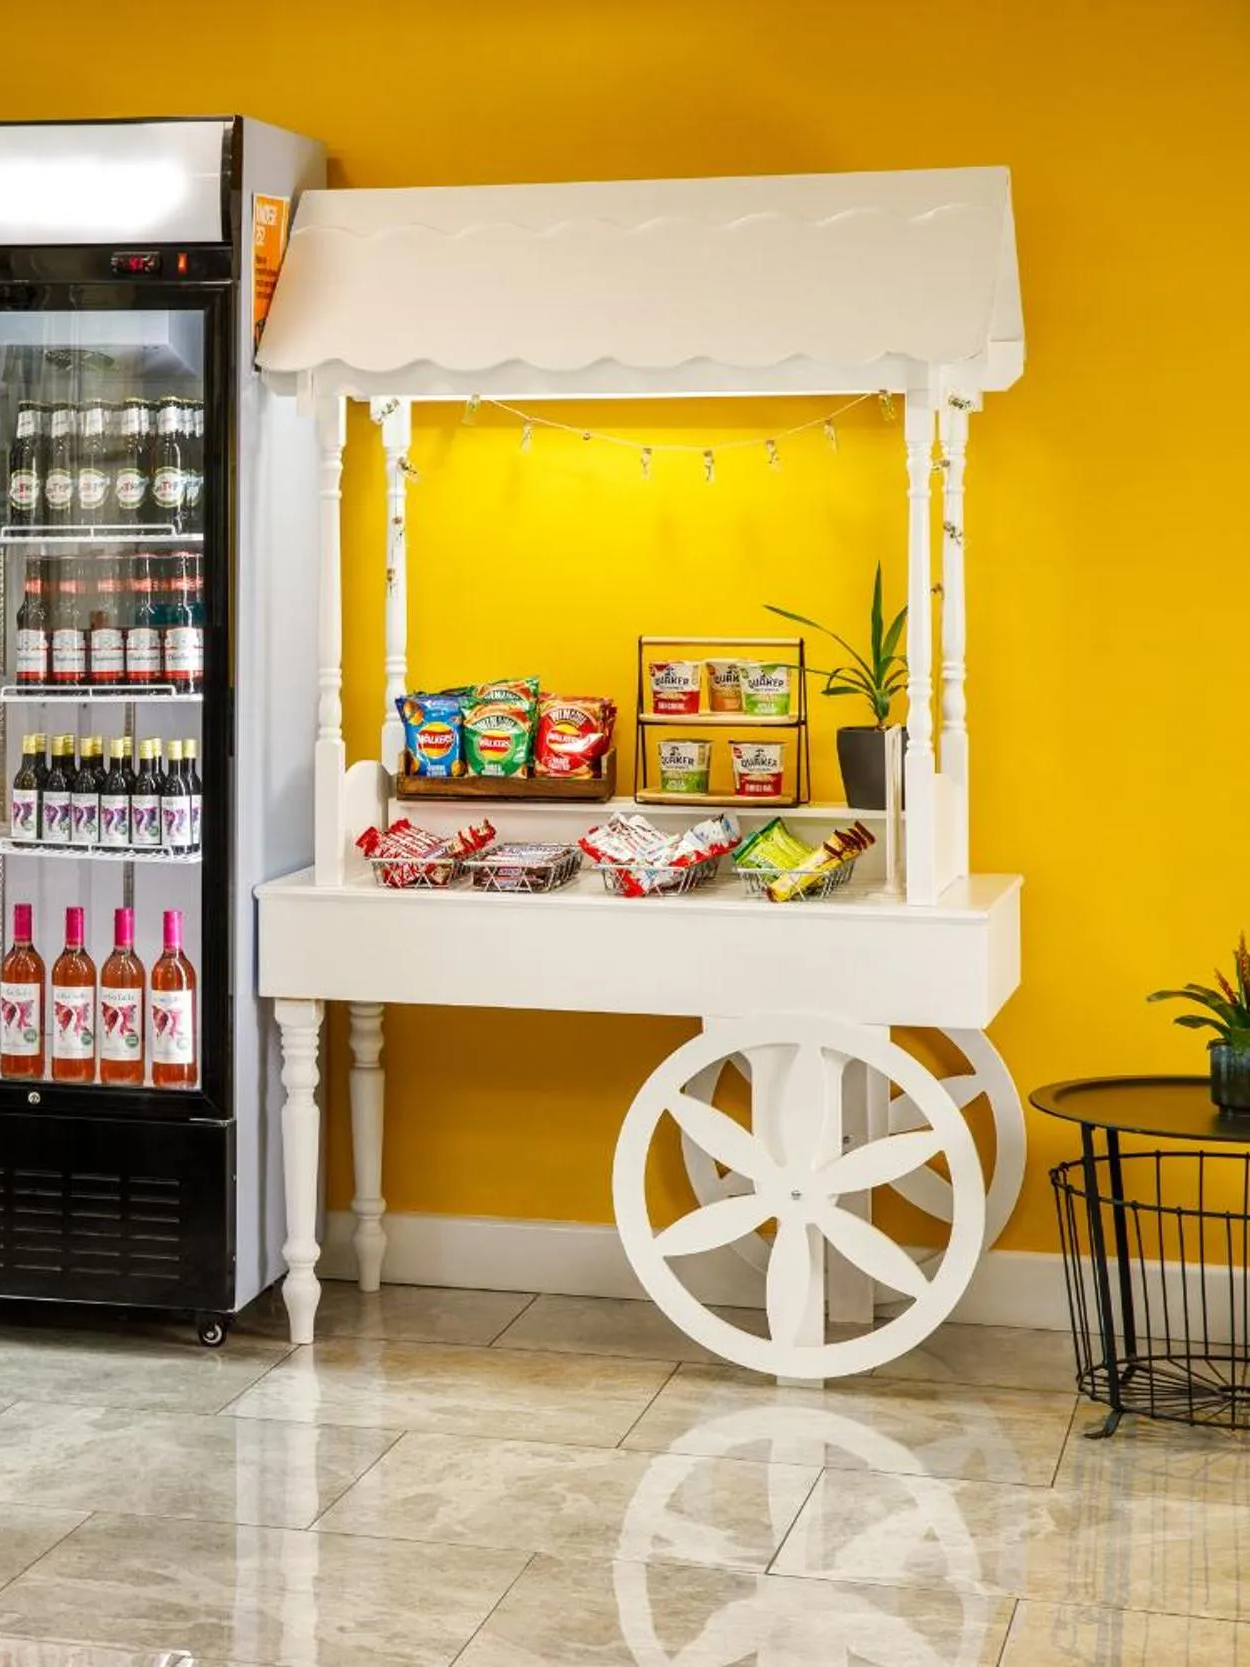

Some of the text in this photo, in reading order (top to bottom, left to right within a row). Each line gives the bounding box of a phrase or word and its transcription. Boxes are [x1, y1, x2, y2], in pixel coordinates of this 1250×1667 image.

[654, 677, 689, 687] QUAKER
[714, 674, 740, 685] QUAK
[748, 678, 784, 689] QUAKER
[417, 733, 455, 745] WALKERS
[480, 738, 511, 748] WALKERS
[741, 759, 777, 768] QUAKER
